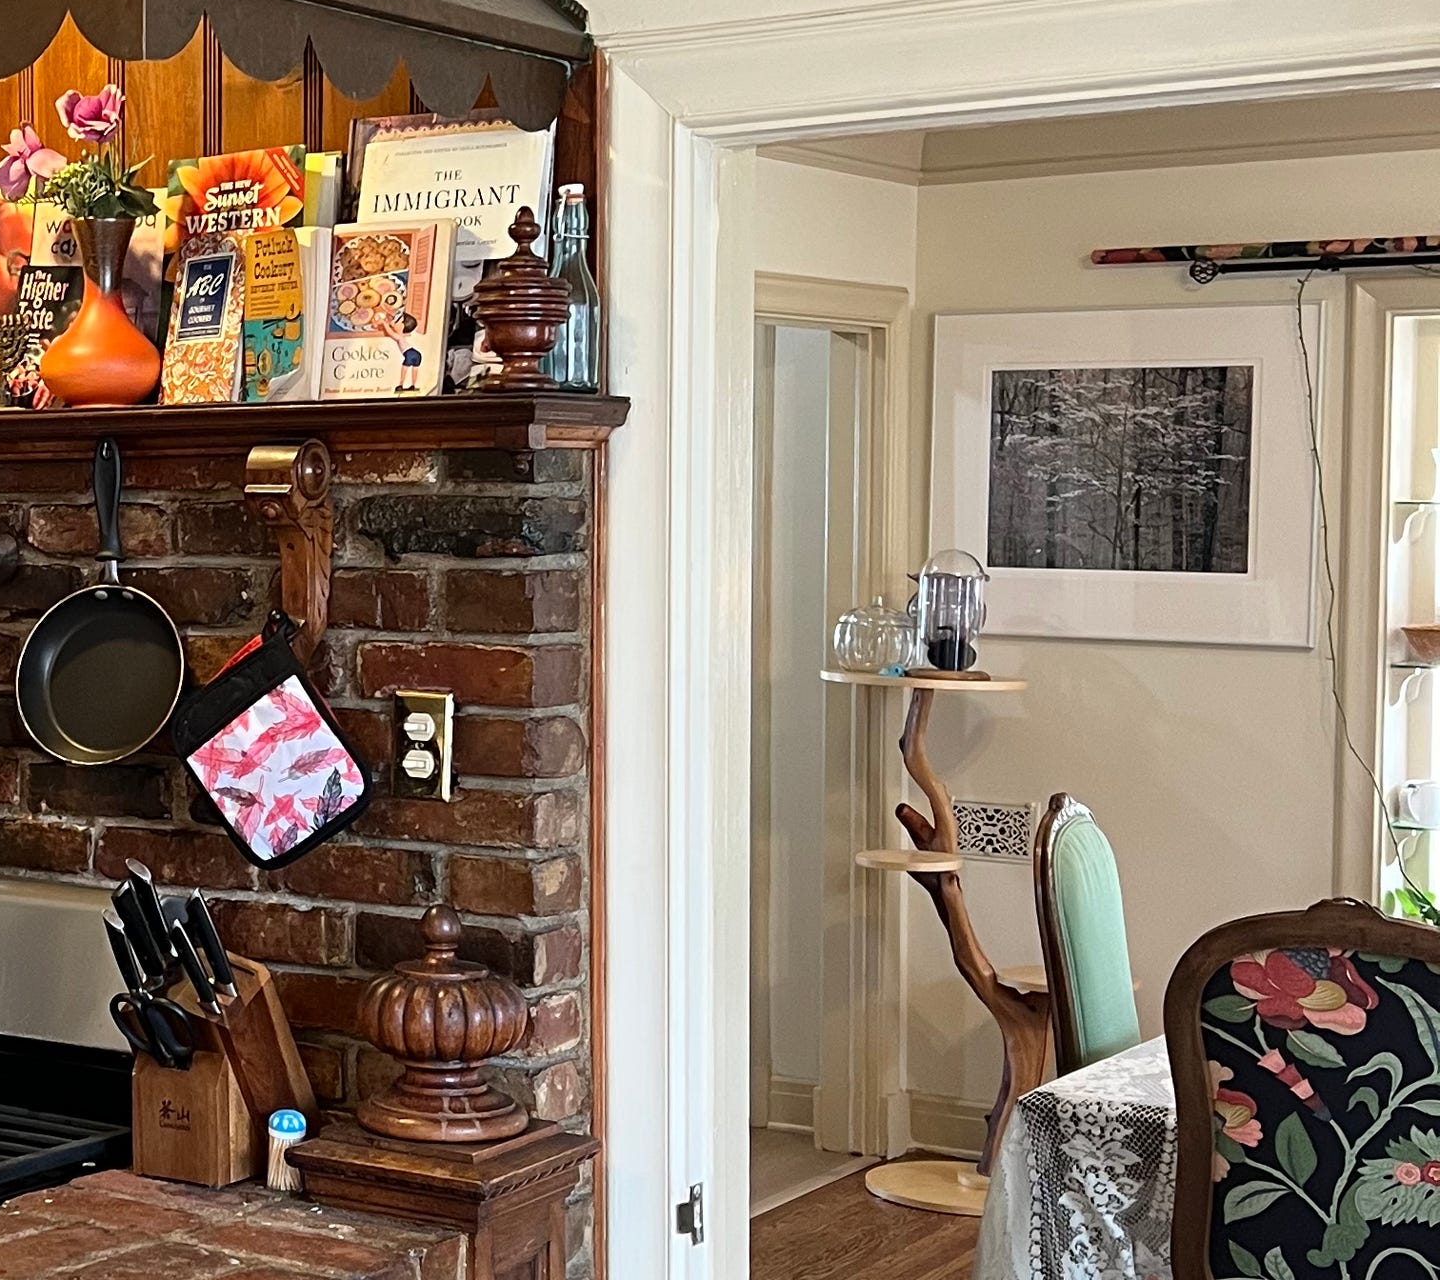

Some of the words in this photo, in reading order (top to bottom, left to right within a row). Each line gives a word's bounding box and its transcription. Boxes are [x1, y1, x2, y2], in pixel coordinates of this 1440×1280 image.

[434, 169, 462, 182] THE
[203, 181, 264, 212] Sunset
[373, 184, 520, 214] IMMIGRANT
[185, 206, 282, 234] WESTERN
[455, 215, 482, 228] OOK
[255, 236, 294, 258] Potluck
[254, 260, 295, 280] Cookery
[20, 273, 69, 309] Higher
[186, 273, 225, 298] ABC
[19, 301, 54, 330] Taste
[332, 345, 390, 362] Cookies
